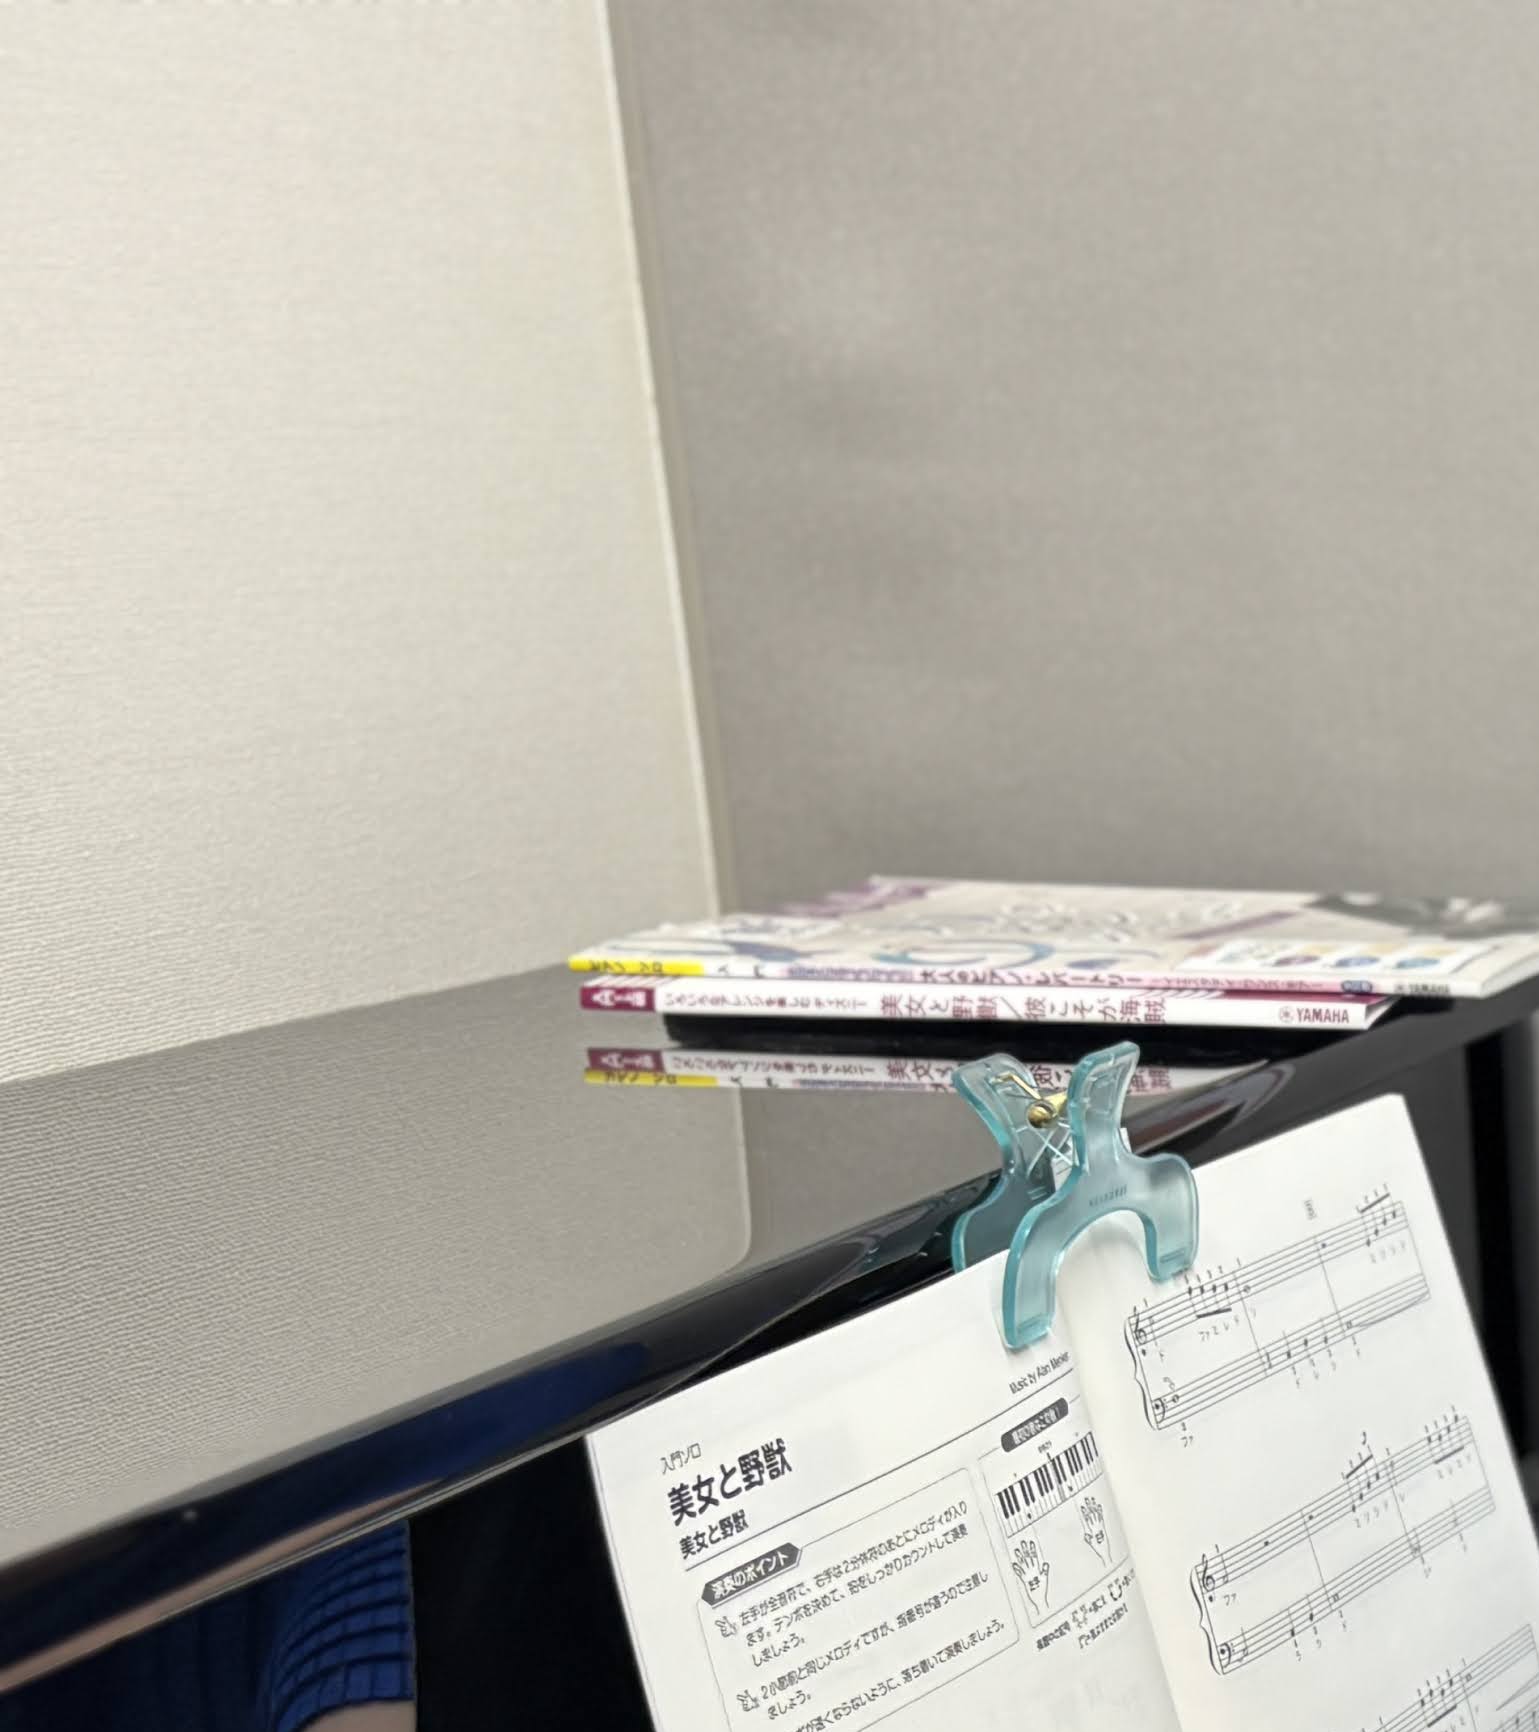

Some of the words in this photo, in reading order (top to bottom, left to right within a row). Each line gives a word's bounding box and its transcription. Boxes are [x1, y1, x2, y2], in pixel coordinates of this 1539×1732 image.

[1296, 1007, 1350, 1024] YAMAHA
[661, 1443, 702, 1475] 入門ソロ
[667, 1437, 793, 1526] 美女と野獣
[679, 1508, 750, 1561] 美女と野獣
[711, 1549, 790, 1602] 演奏のポイント
[751, 1633, 807, 1668] しましょう。
[767, 1692, 813, 1720] ましょう。
